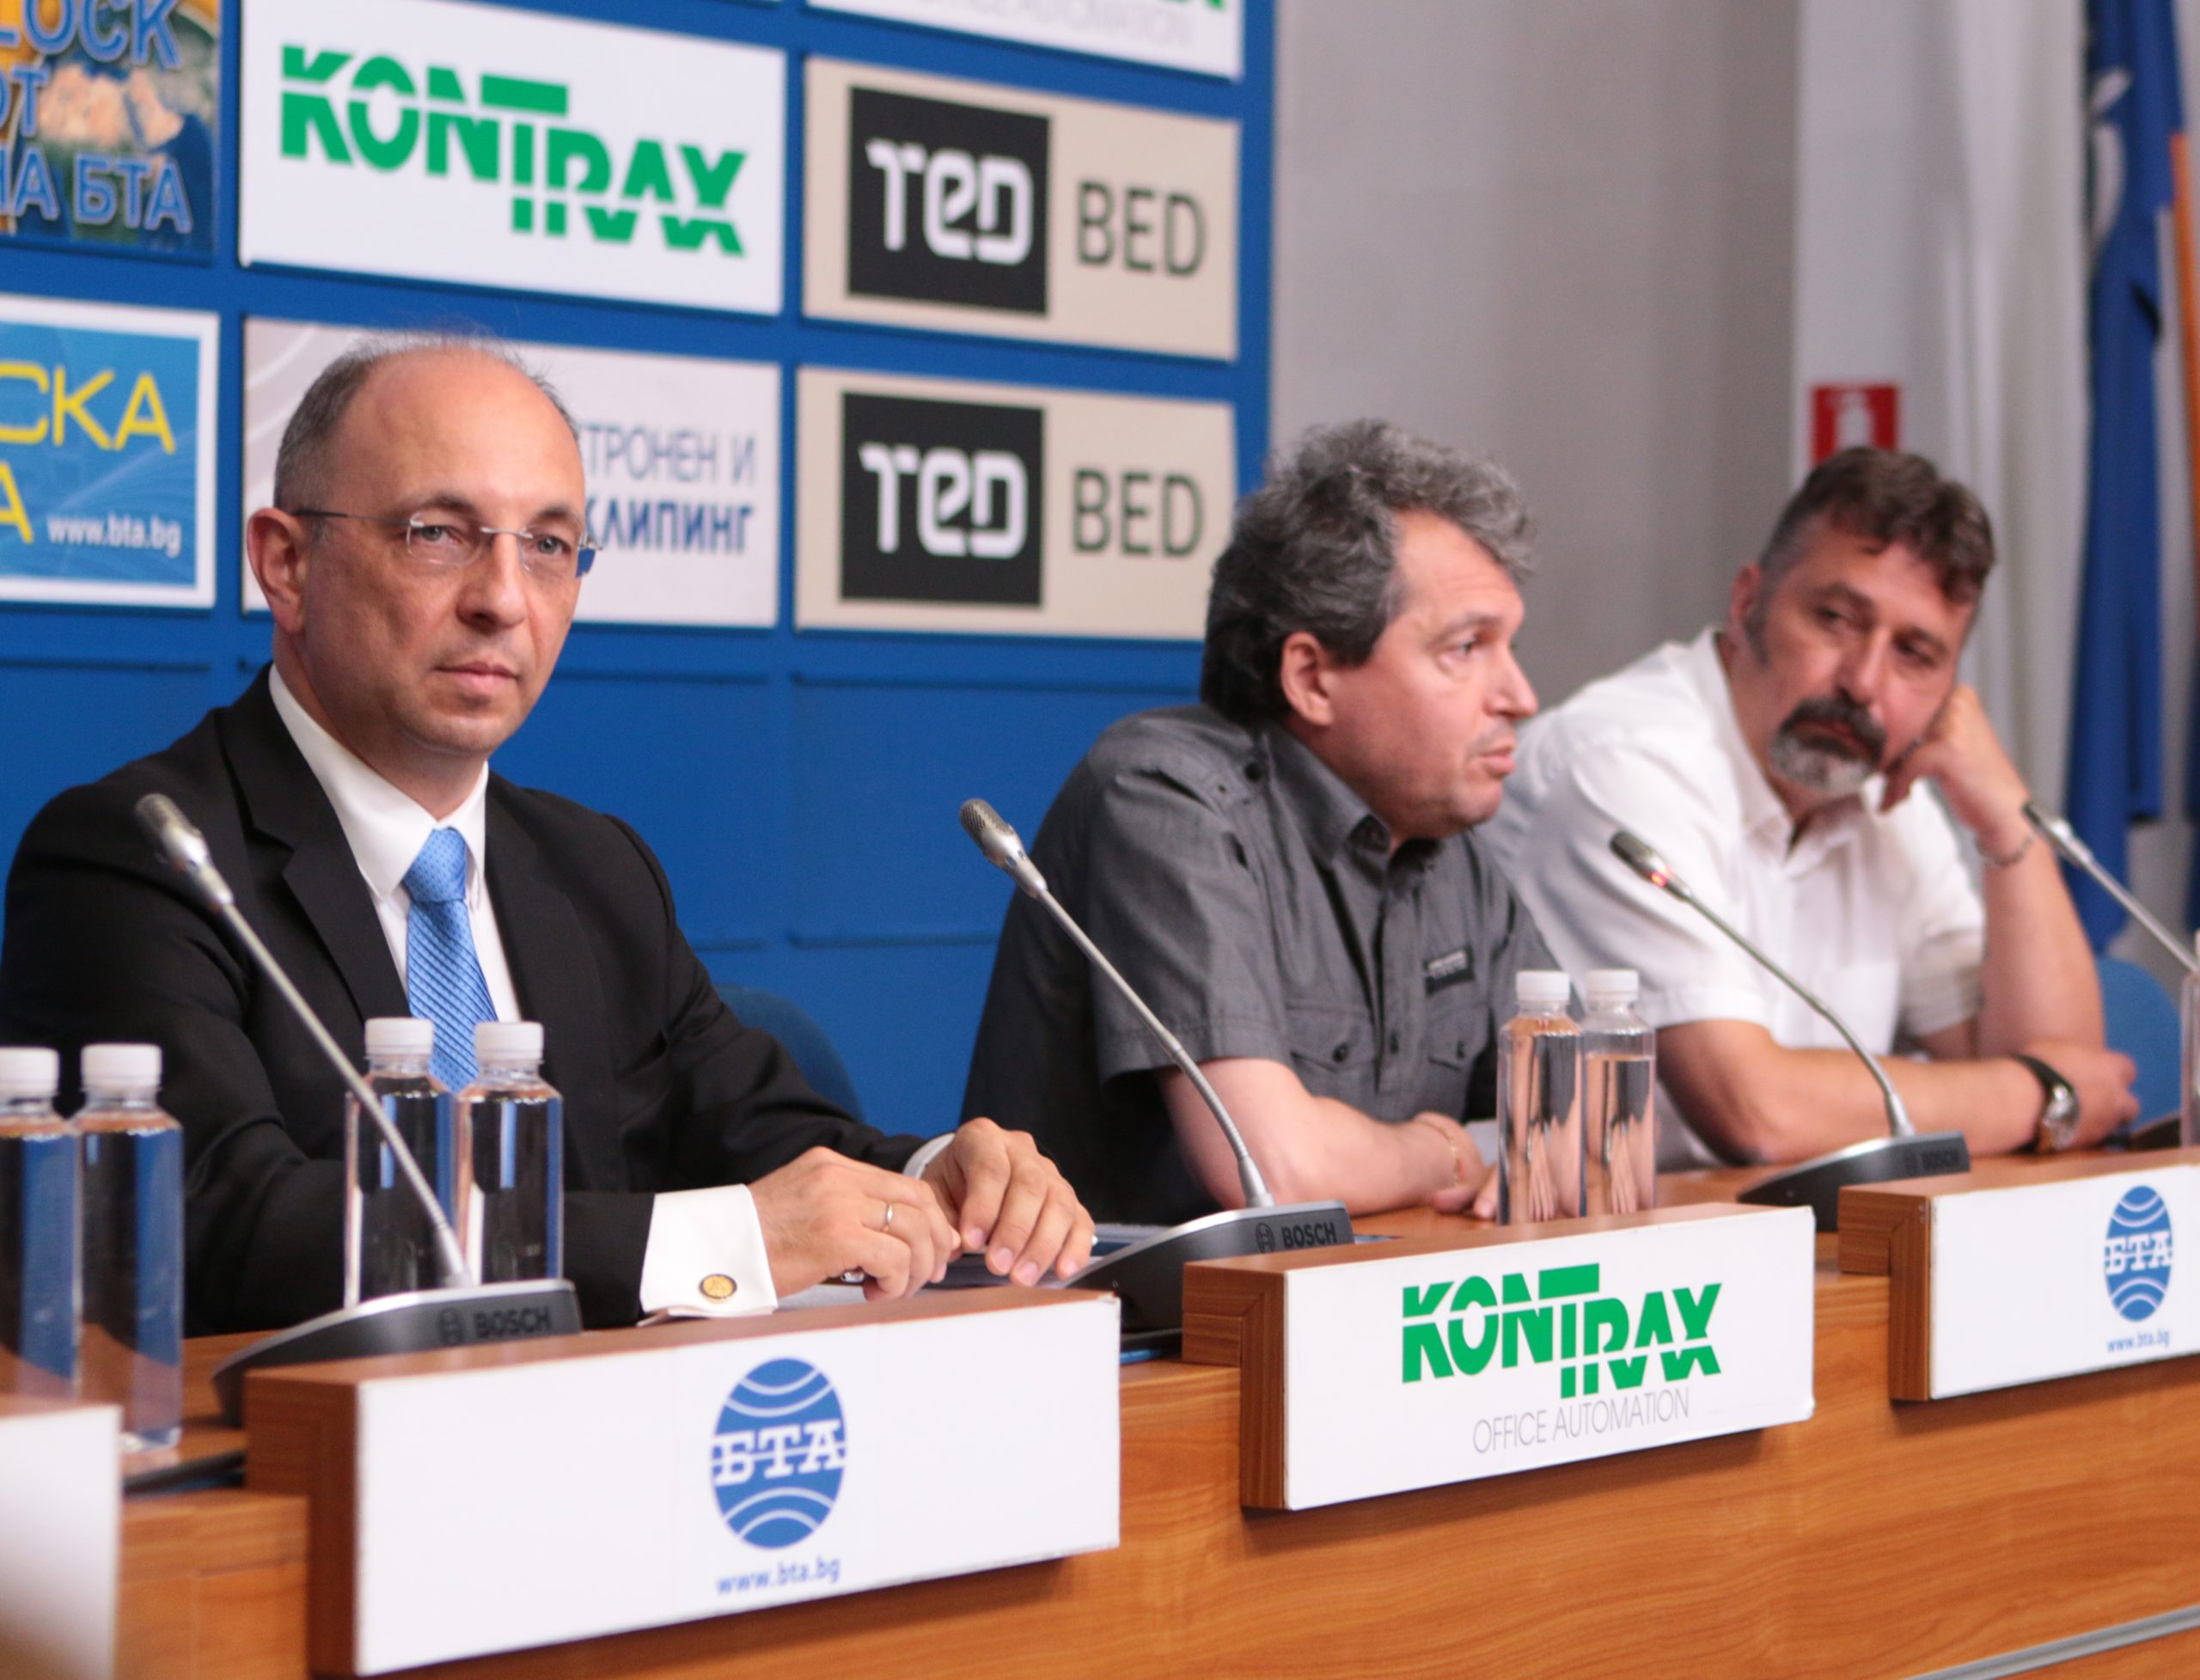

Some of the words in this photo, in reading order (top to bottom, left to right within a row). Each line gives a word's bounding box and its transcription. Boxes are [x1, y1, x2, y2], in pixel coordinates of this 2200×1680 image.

[0, 0, 181, 69] OCK
[0, 65, 50, 137] Т
[280, 44, 748, 258] KONTRAX
[0, 144, 60, 220] А
[74, 152, 192, 233] БТА
[1077, 180, 1207, 276] BED
[731, 432, 755, 486] И
[46, 512, 182, 559] www.bta.bg
[1072, 468, 1204, 557] BED
[1281, 1222, 1337, 1249] BOSCH
[2105, 1230, 2172, 1276] БТА
[474, 1307, 550, 1338] BOSCH
[1402, 1262, 1722, 1399] KONTRAX
[2107, 1329, 2171, 1353] www.bta.bg
[712, 1420, 846, 1488] БТА
[1472, 1409, 1547, 1454] OFFICE
[1552, 1386, 1690, 1442] AUTOMATION
[716, 1555, 841, 1596] www.bta.bg
